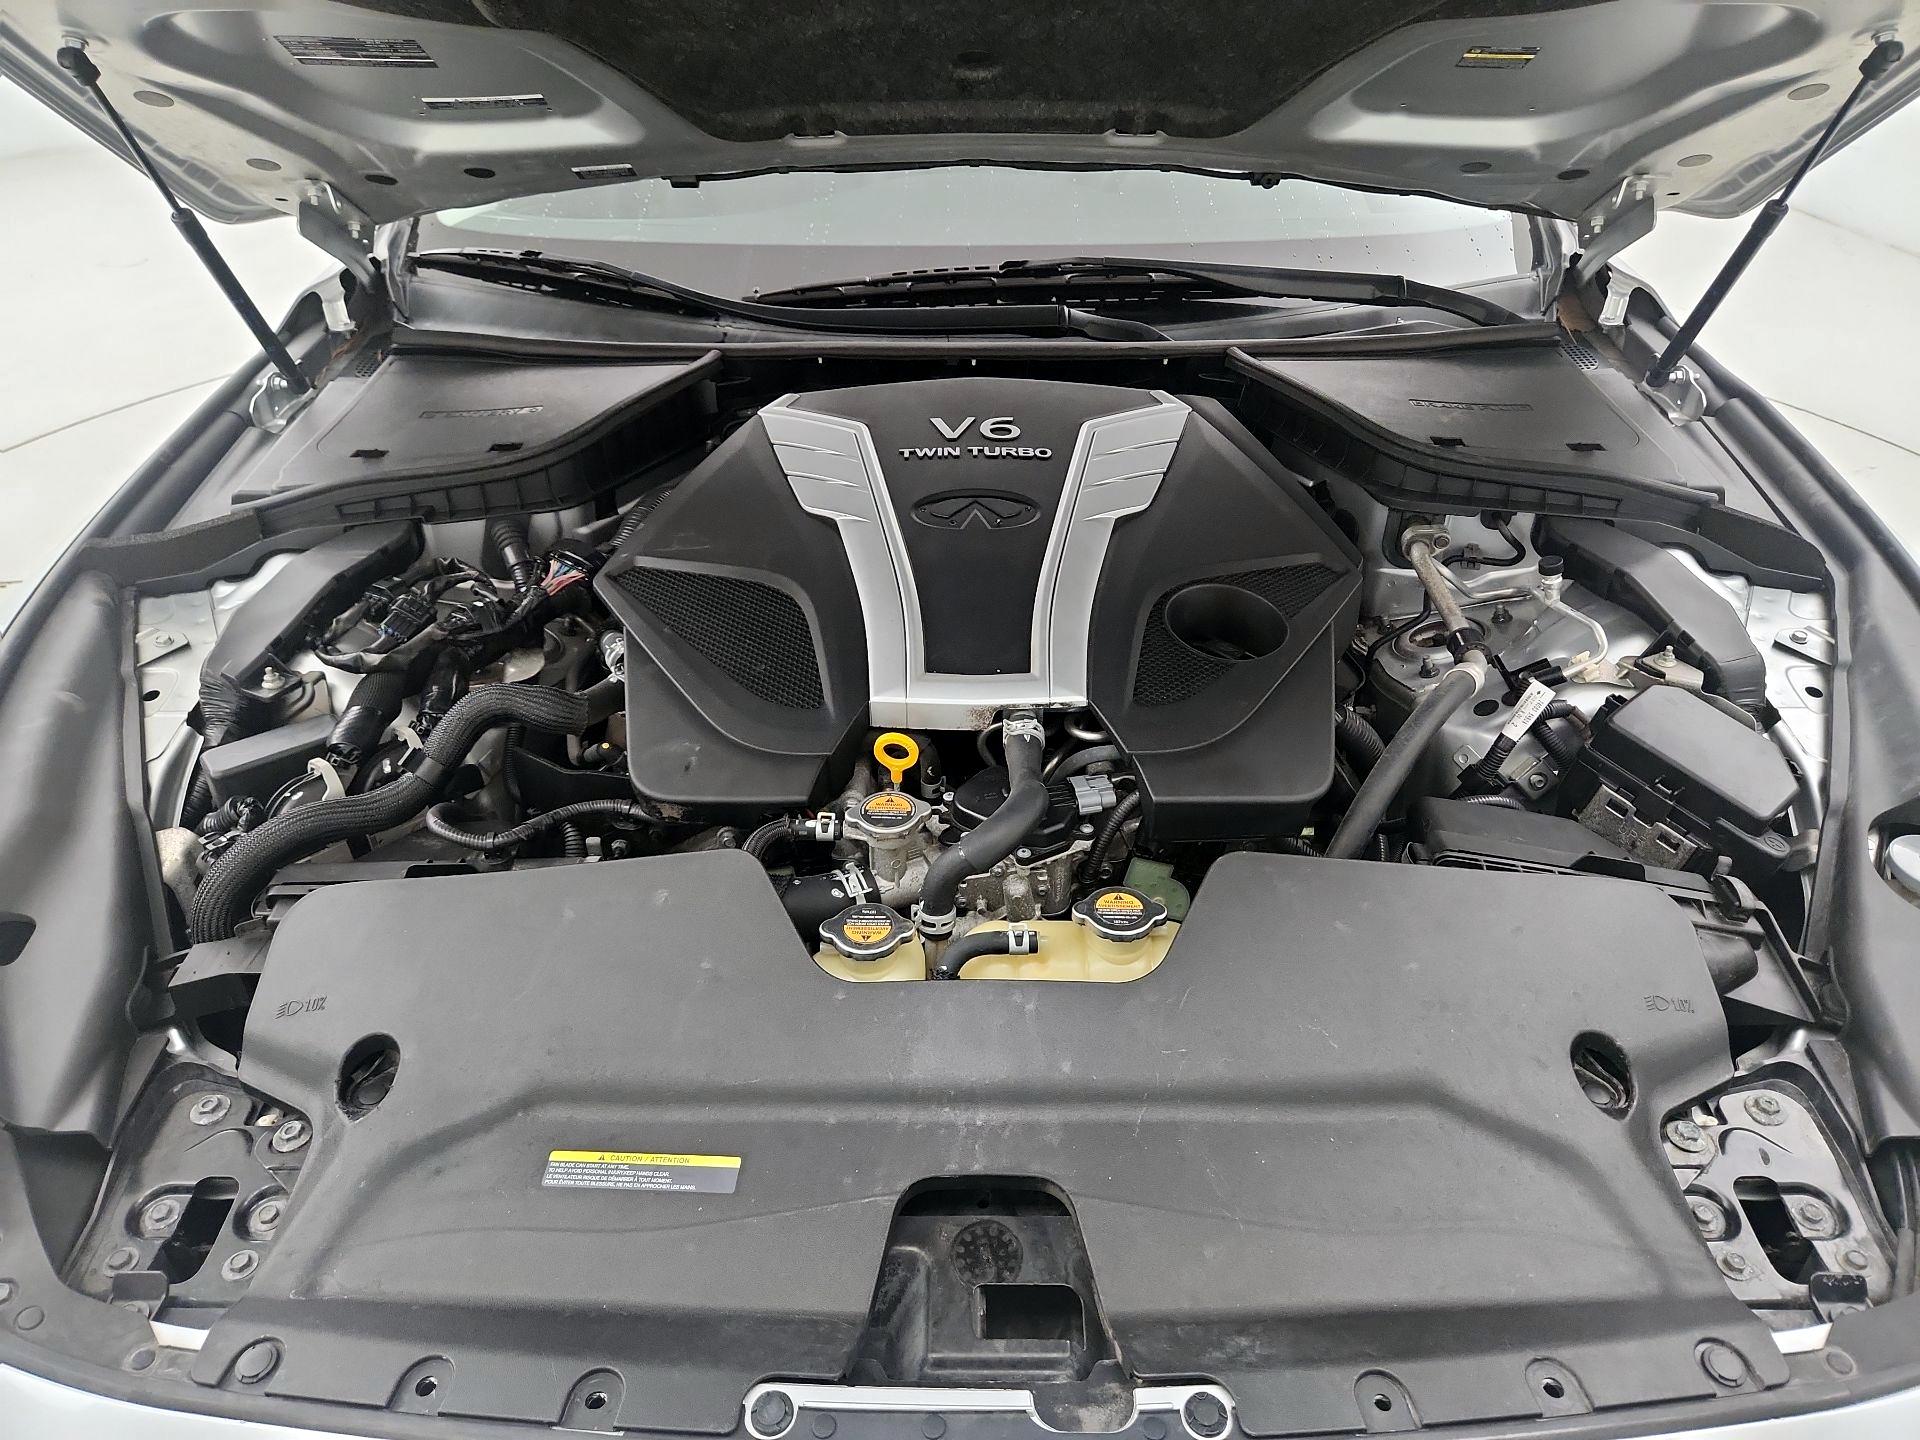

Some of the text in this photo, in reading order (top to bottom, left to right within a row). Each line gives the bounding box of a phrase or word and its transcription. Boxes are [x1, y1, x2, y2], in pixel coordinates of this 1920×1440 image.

[929, 416, 1022, 441] V6
[899, 446, 1053, 460] TWIN TURBO
[649, 1156, 690, 1164] ATTENTION
